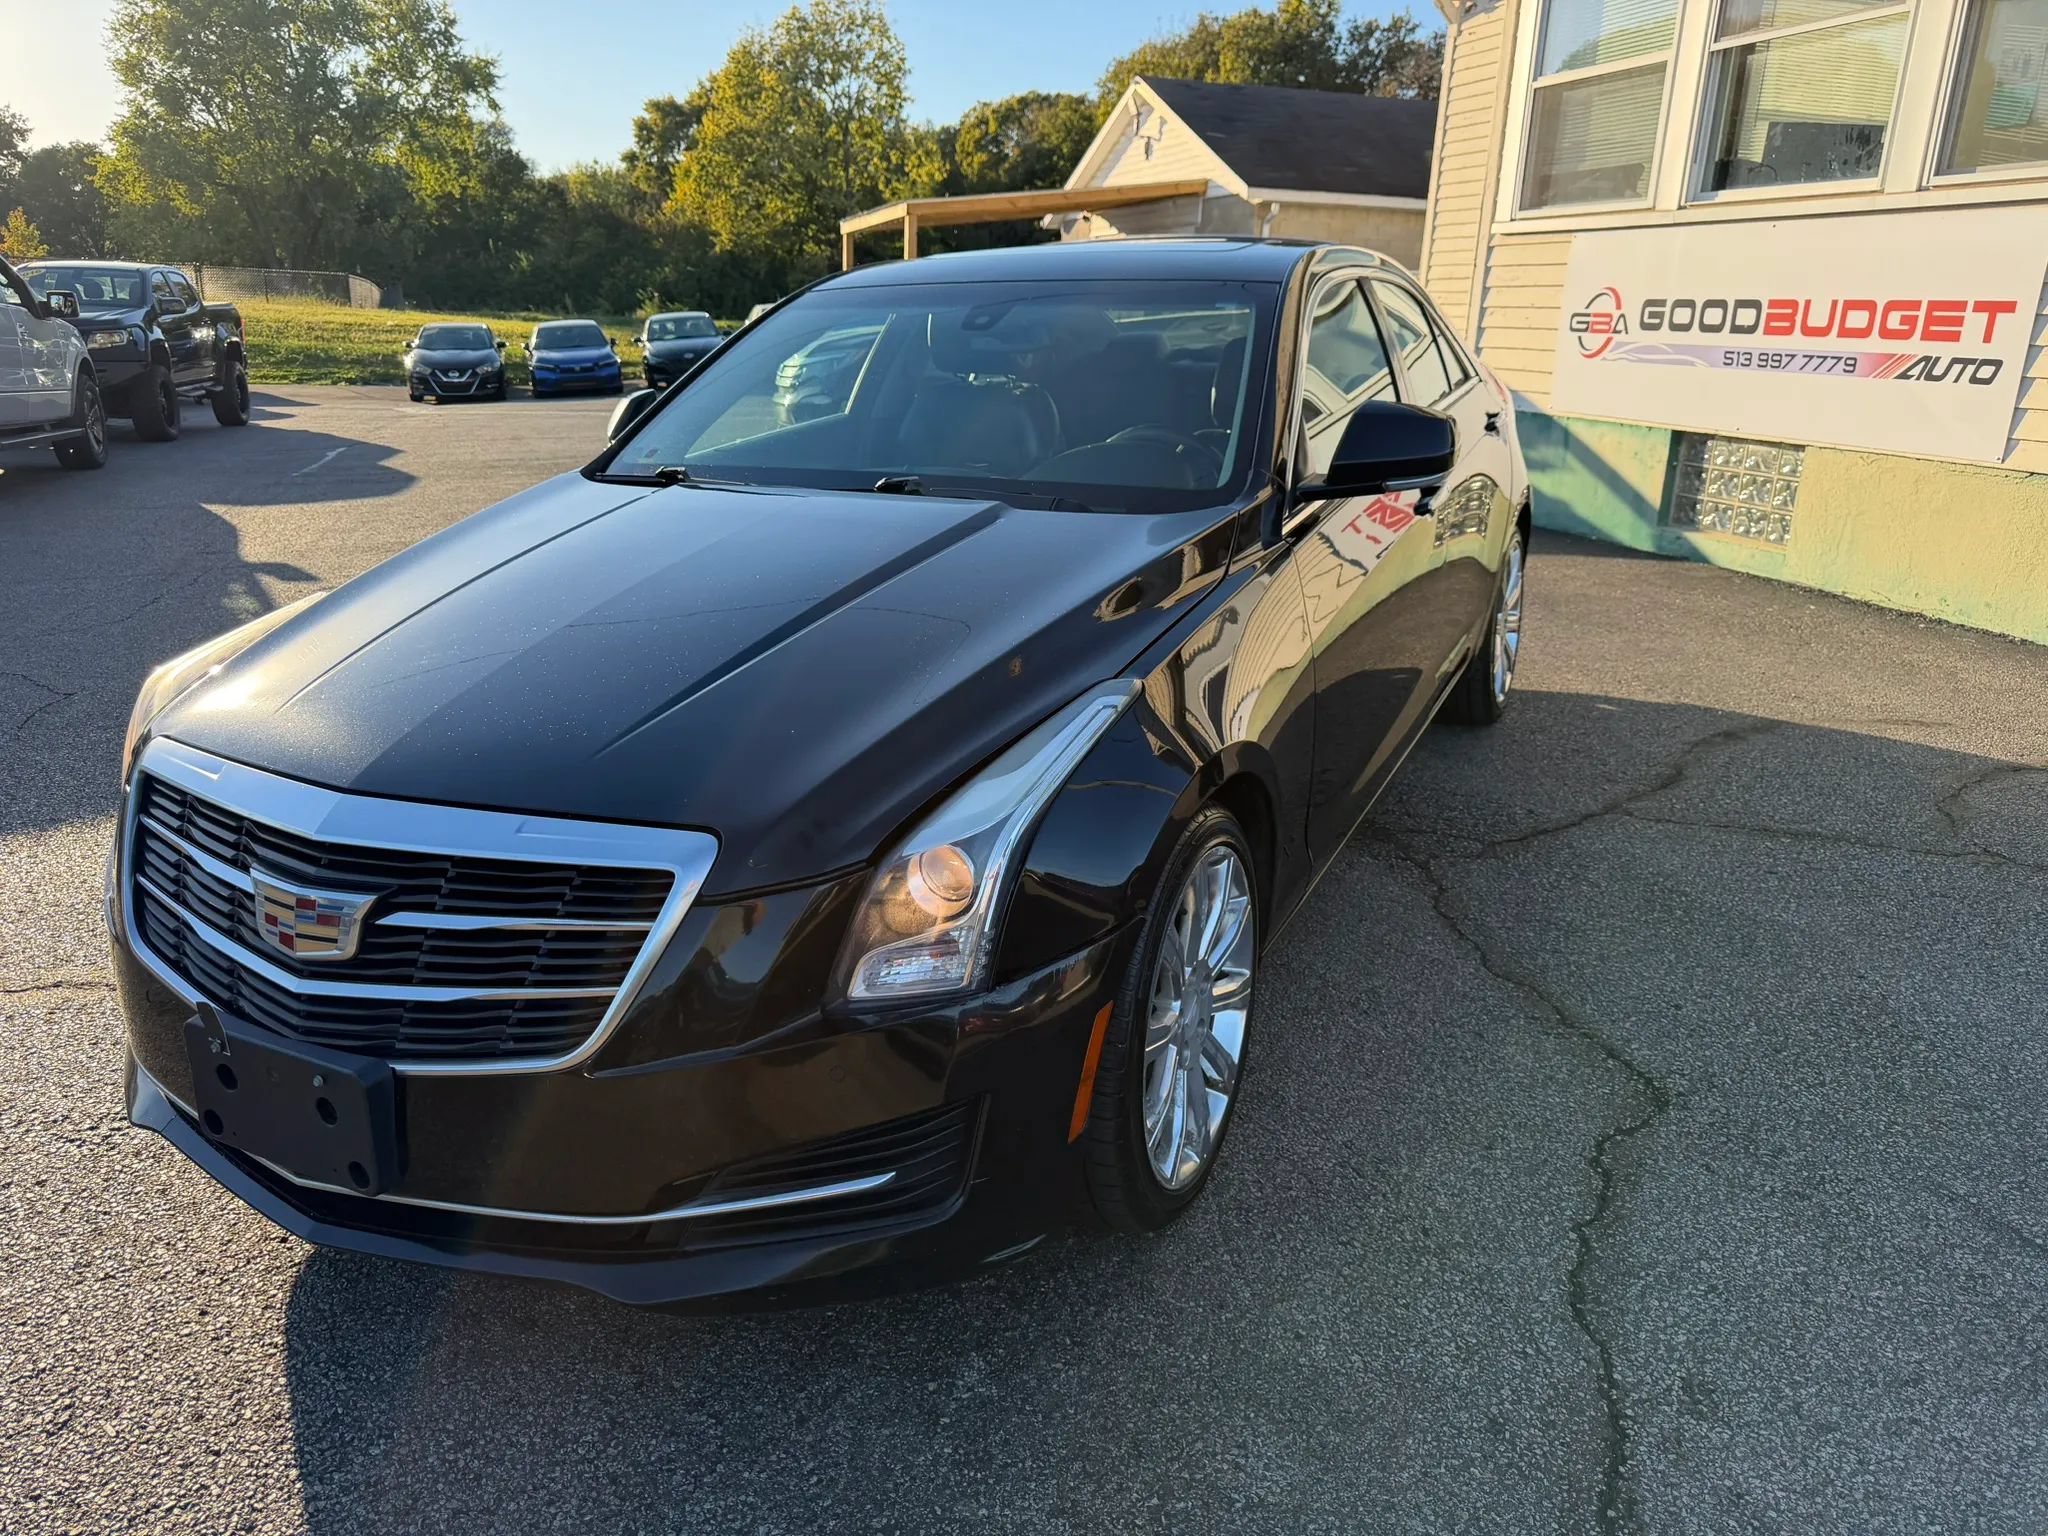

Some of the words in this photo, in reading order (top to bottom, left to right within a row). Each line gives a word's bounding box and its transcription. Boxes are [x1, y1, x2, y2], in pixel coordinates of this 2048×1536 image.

[1569, 312, 1629, 335] GBA
[1722, 350, 1753, 368] 513
[1757, 352, 1798, 370] 997
[1799, 354, 1858, 374] 7779
[1893, 355, 2004, 386] AUTO
